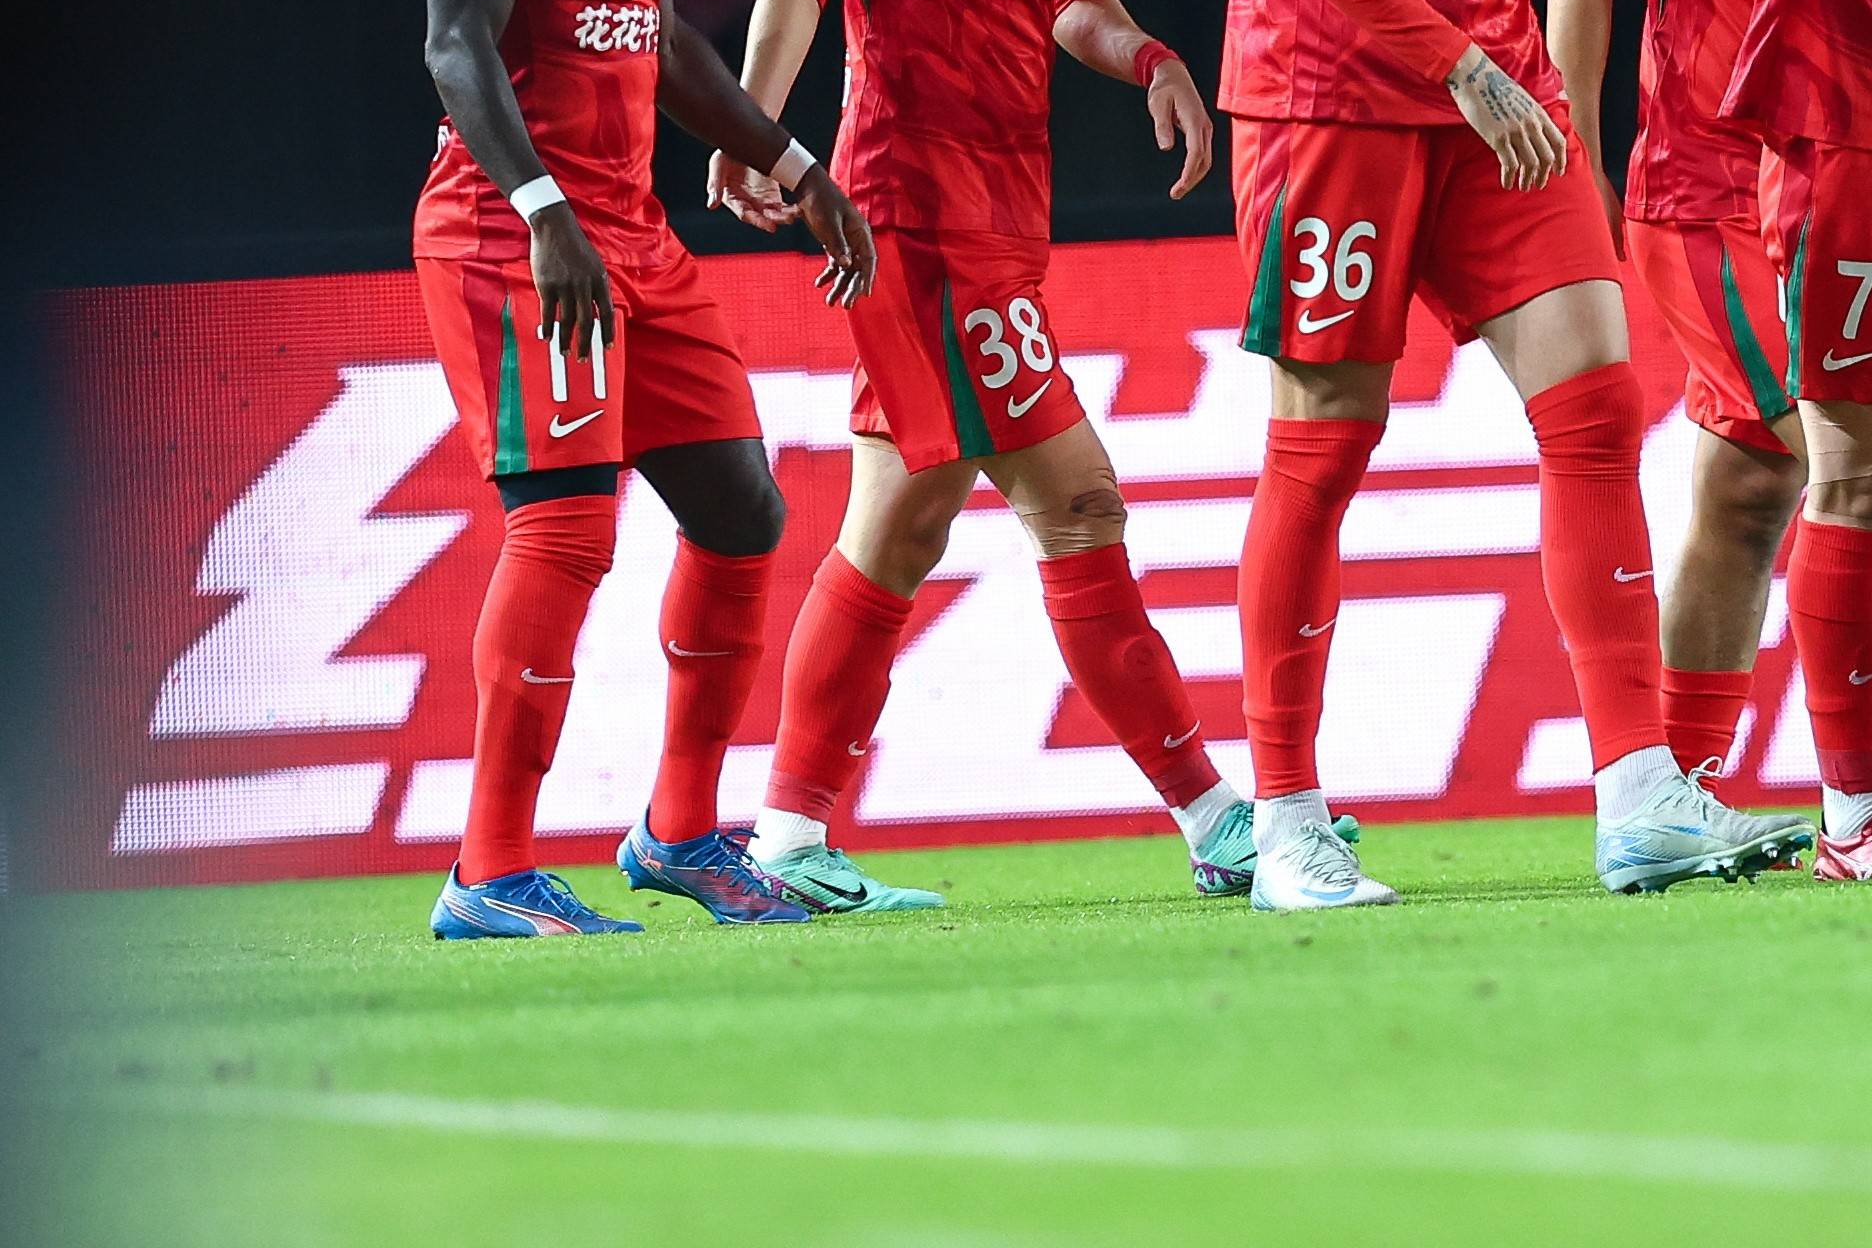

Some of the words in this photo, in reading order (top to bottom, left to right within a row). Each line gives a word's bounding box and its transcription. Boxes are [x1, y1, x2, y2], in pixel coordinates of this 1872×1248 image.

[574, 3, 660, 54] 花花牛
[1290, 216, 1377, 302] 36
[537, 315, 607, 403] 11
[964, 296, 1055, 390] 38
